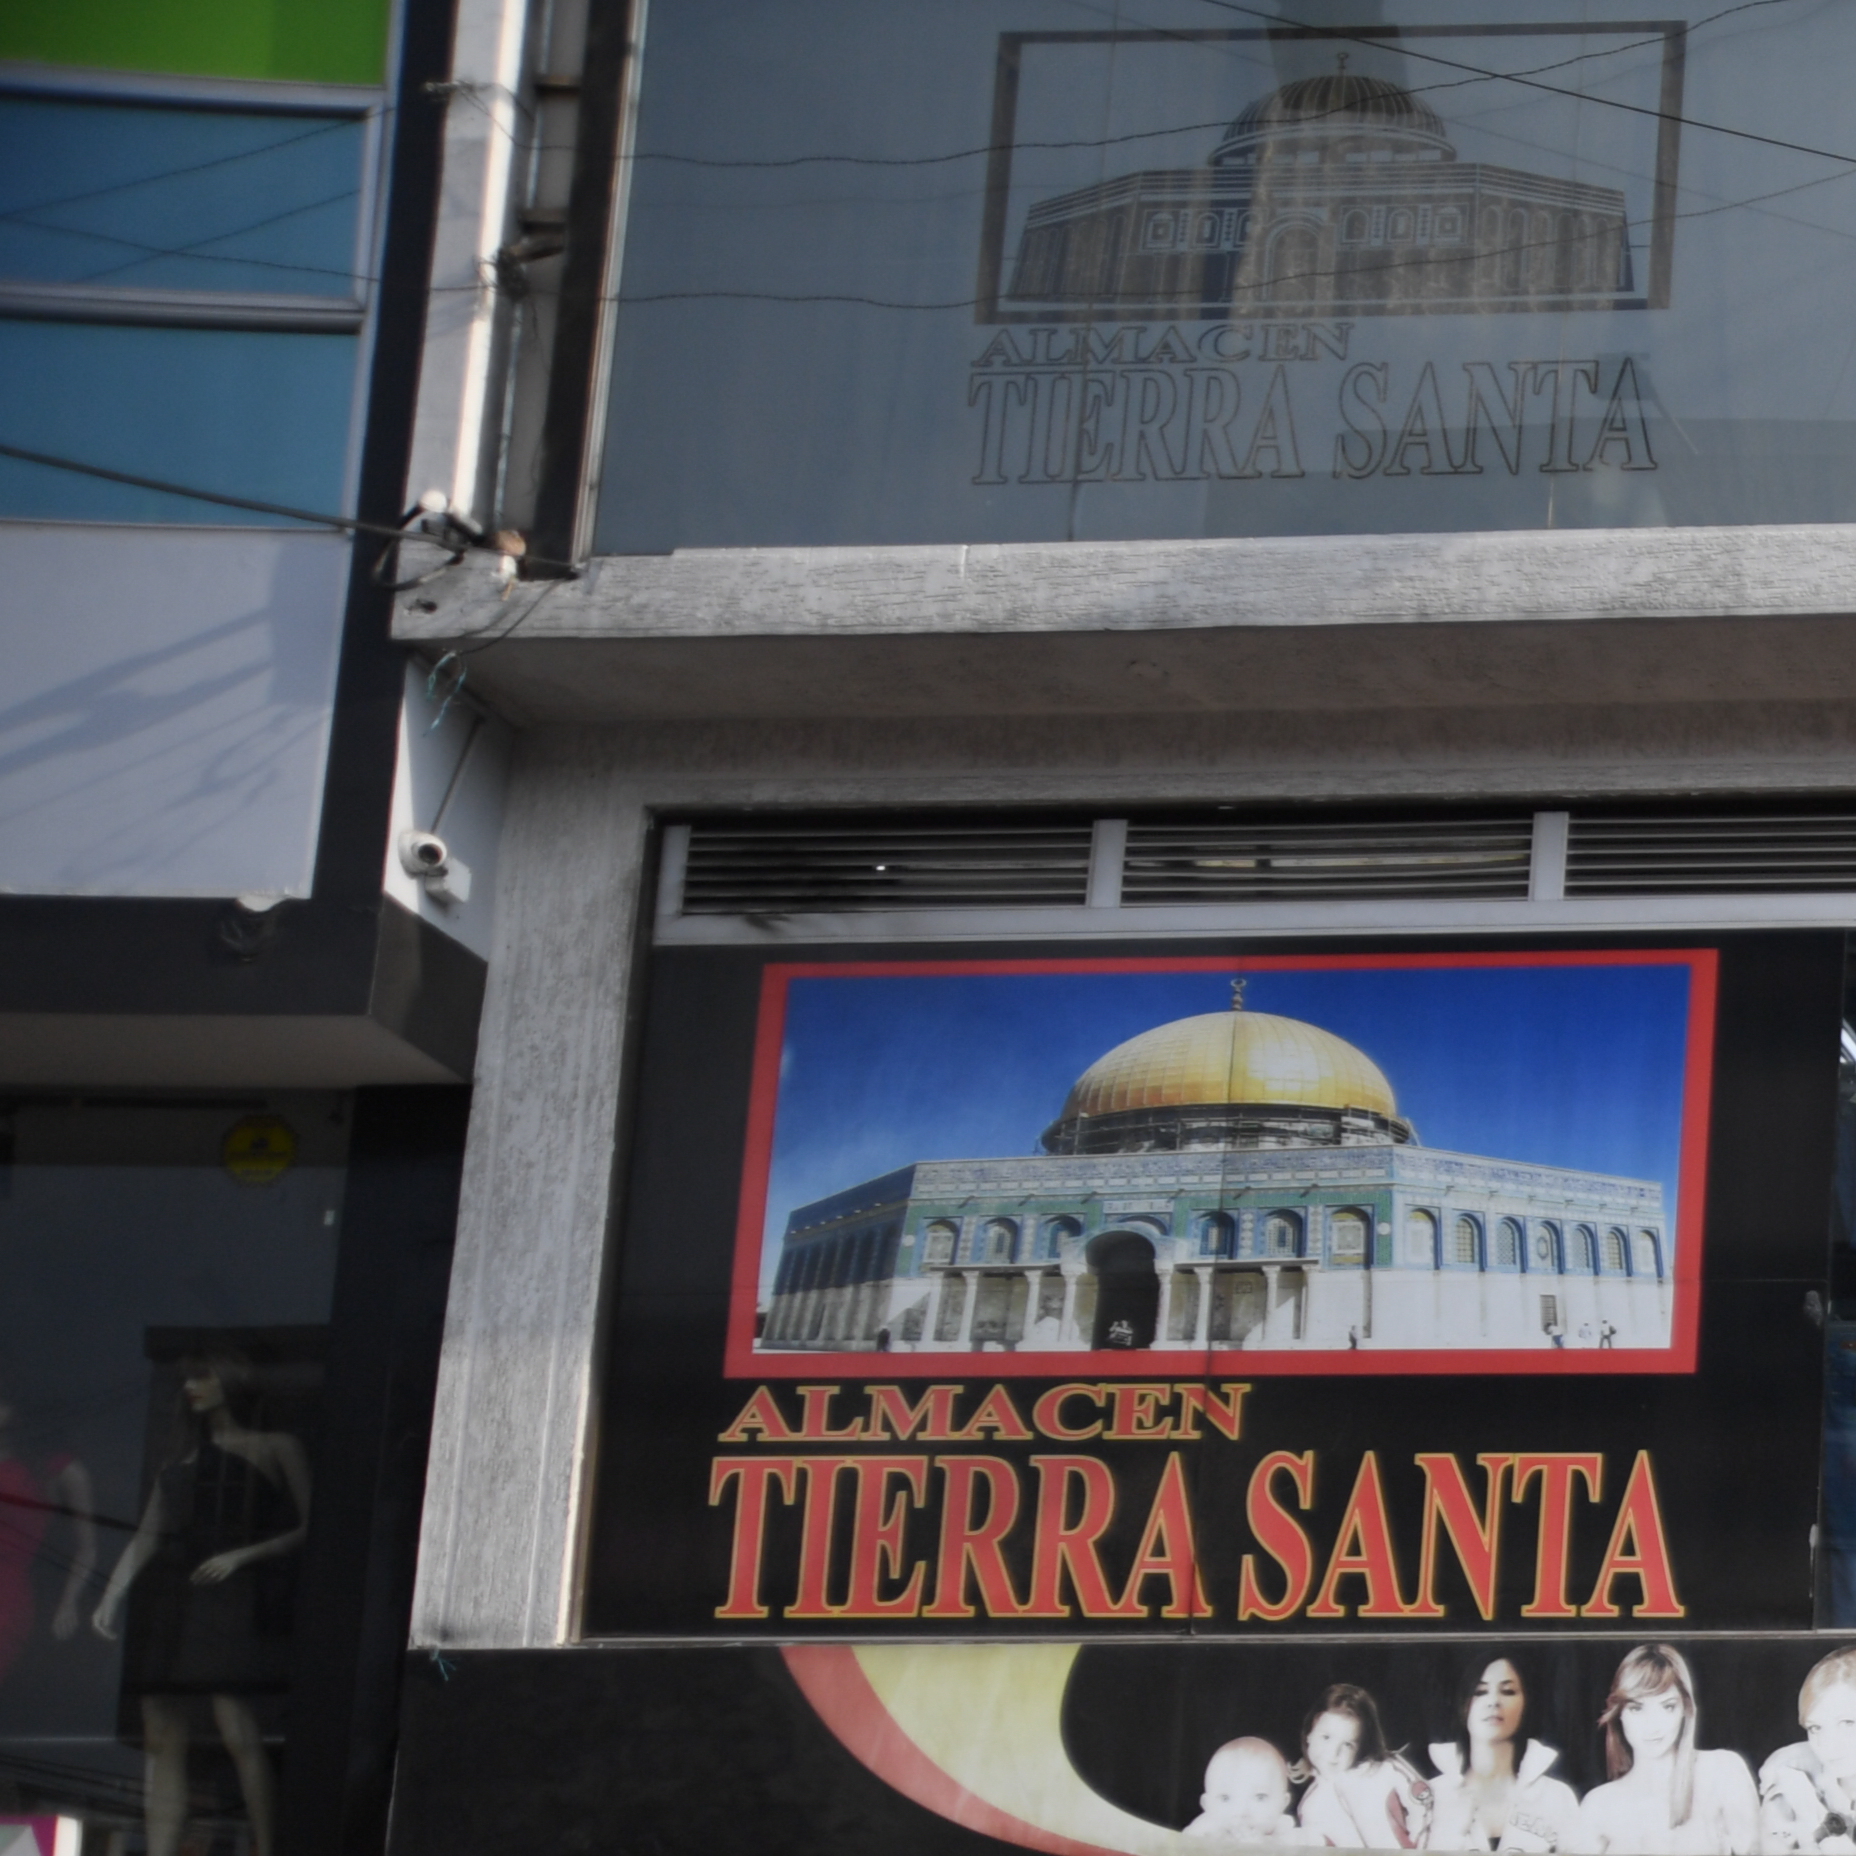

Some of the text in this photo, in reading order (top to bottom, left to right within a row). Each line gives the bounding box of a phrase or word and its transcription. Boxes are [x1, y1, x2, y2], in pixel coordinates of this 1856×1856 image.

[971, 324, 1354, 366] ALMACEN
[968, 357, 1658, 486] TIERRA SANTA
[717, 1382, 1251, 1441] ALMACEN
[708, 1449, 1685, 1621] TIERRA SANTA
